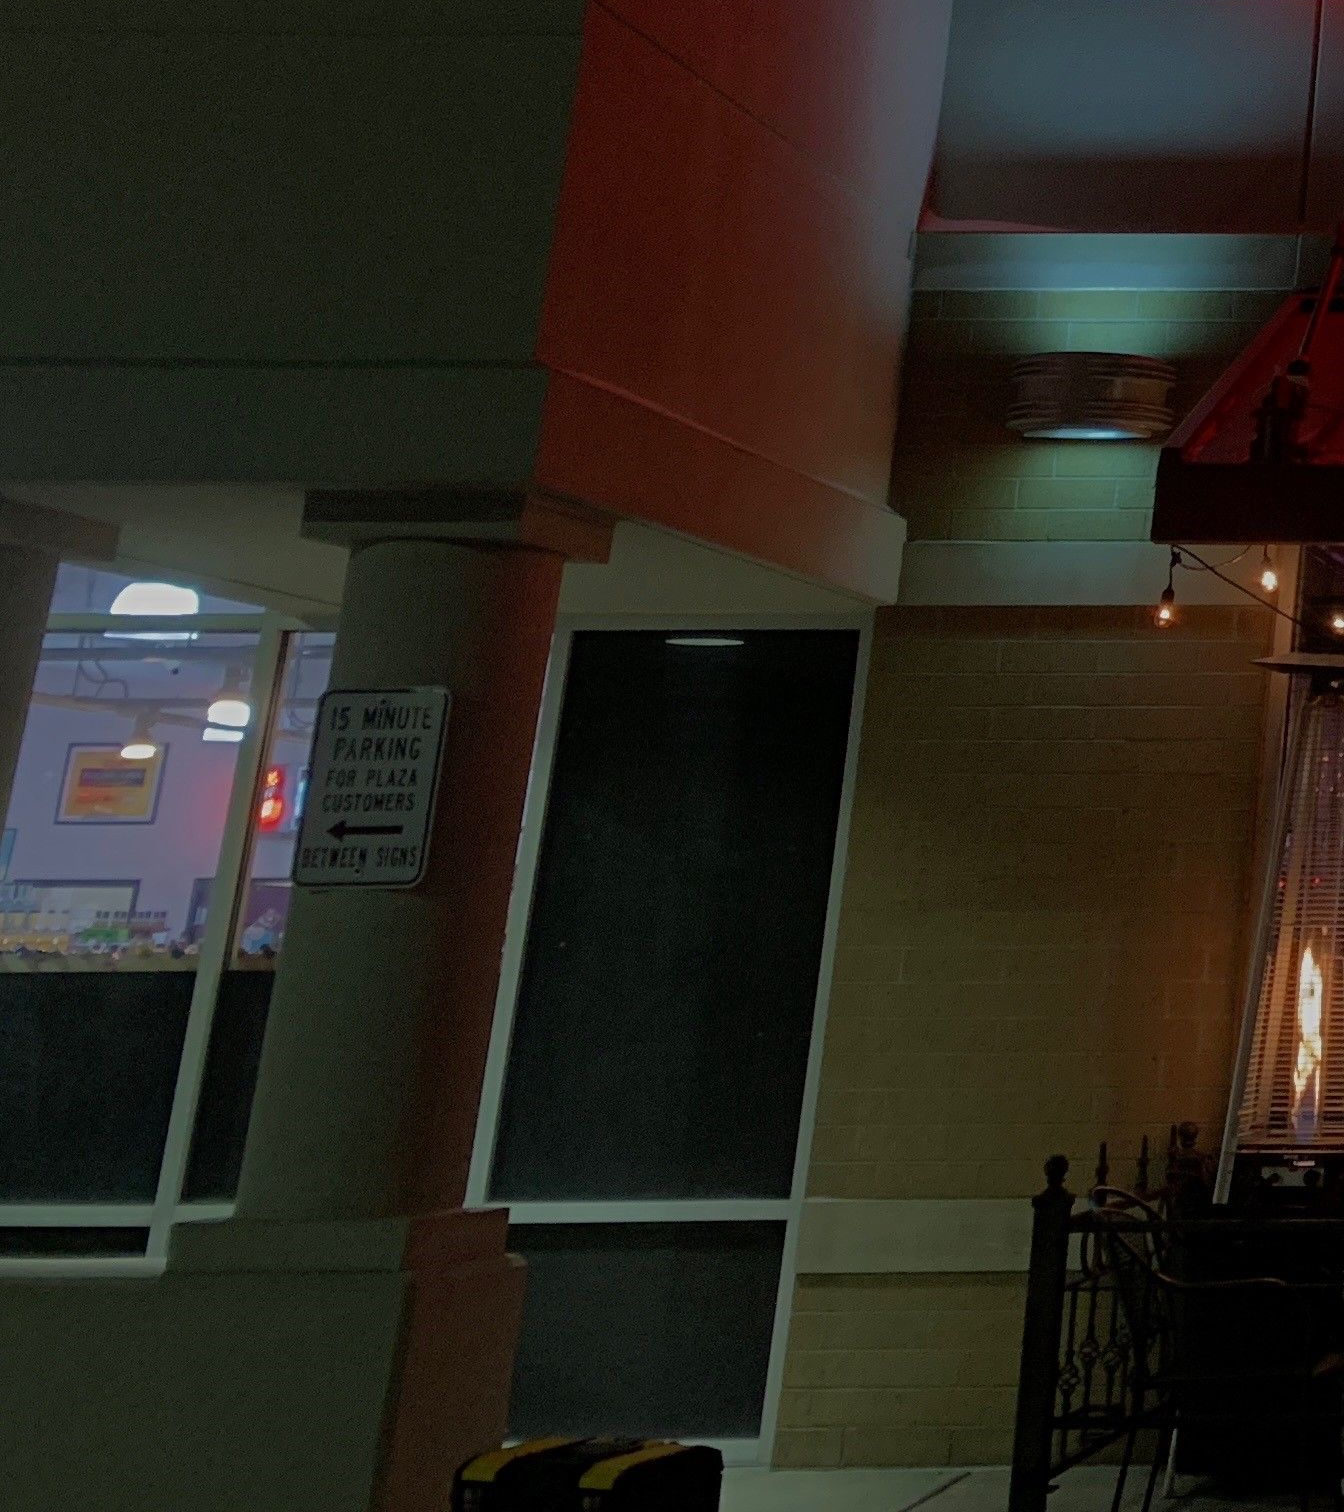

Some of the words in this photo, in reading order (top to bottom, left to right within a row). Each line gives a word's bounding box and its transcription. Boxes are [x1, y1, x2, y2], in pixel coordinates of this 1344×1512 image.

[330, 705, 351, 731] 15
[362, 706, 433, 730] MINUTE
[333, 737, 422, 761] PARKING
[326, 769, 357, 787] FOR
[366, 769, 417, 787] PLAZA
[321, 792, 417, 813] CUSTOMERS
[302, 847, 367, 869] BETWEEN
[376, 846, 419, 868] SIGNS
